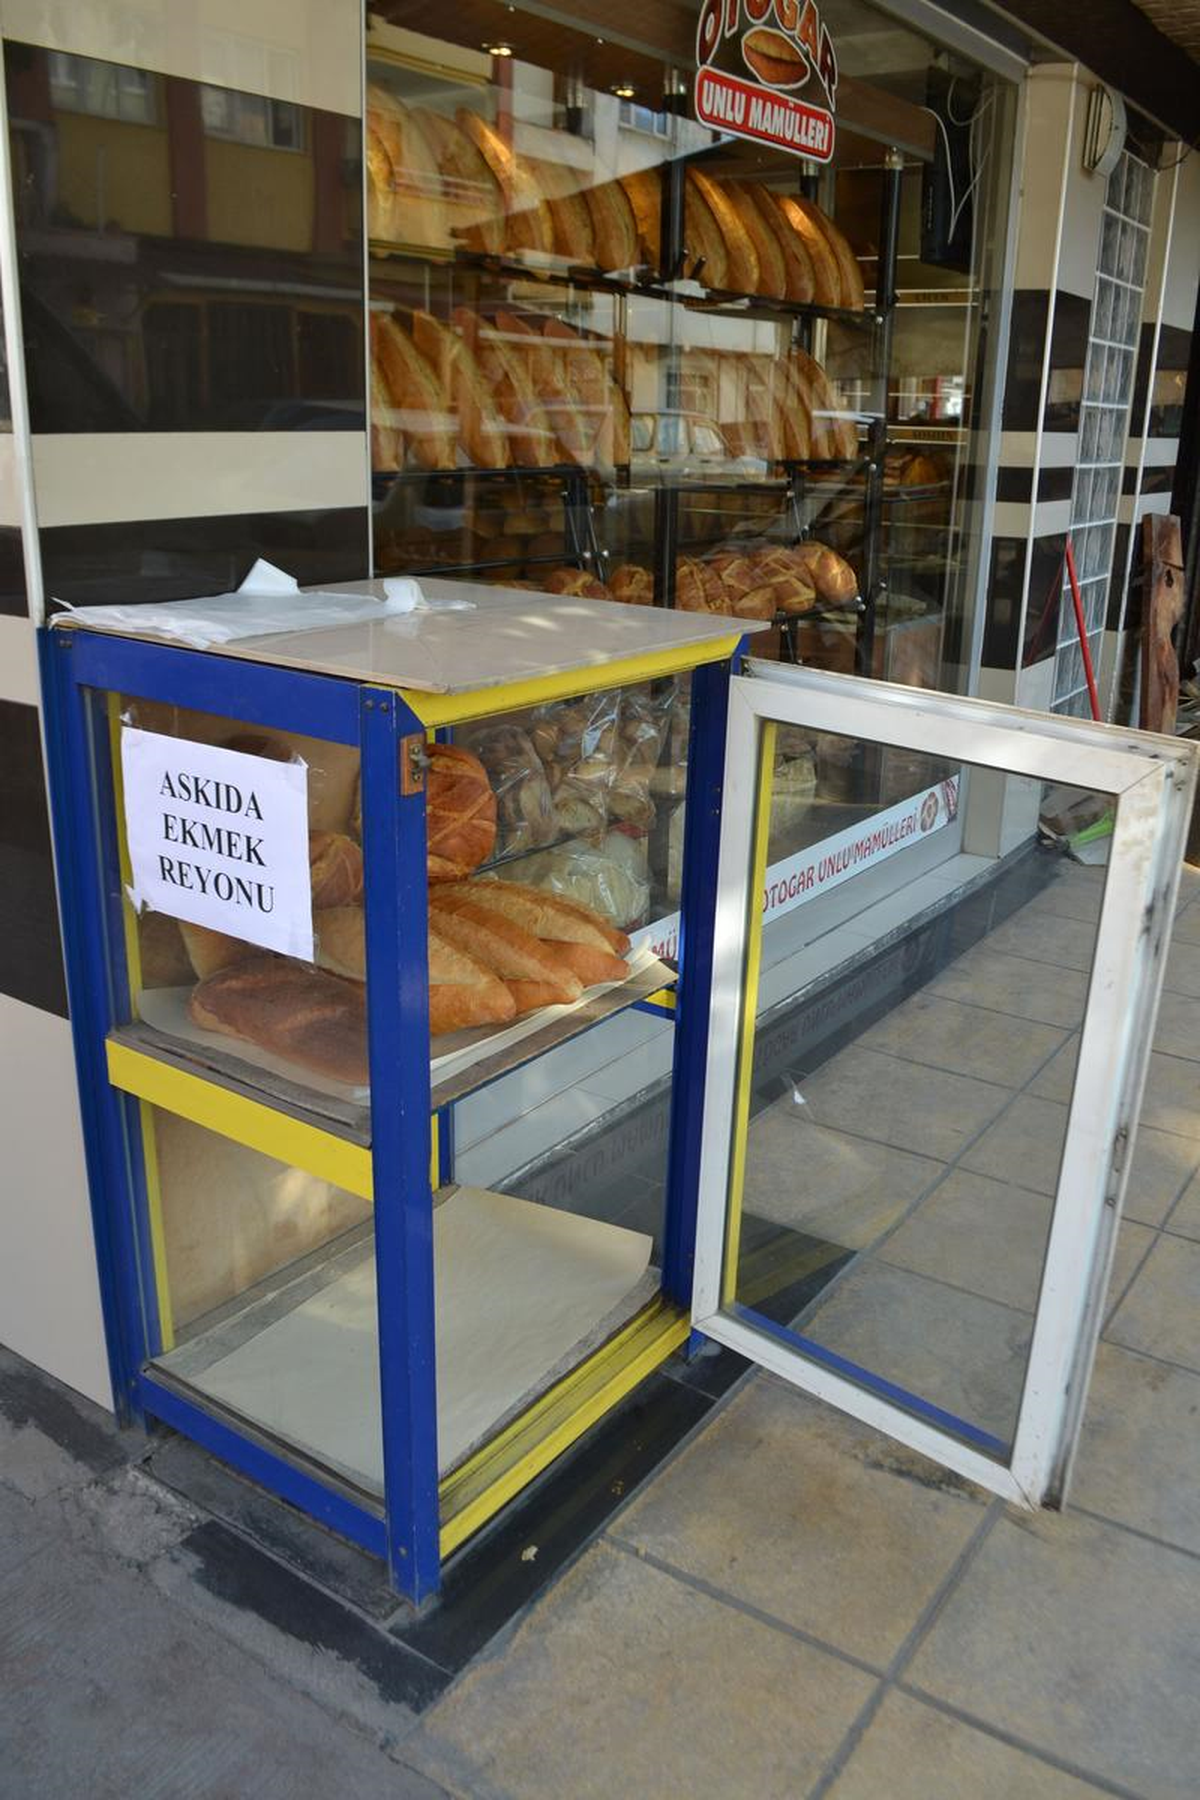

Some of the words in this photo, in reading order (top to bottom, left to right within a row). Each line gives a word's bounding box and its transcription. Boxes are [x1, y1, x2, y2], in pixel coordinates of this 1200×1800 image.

[702, 80, 746, 125] UNLU
[749, 96, 830, 152] MAMÜLLERİ
[159, 770, 264, 821] ASKIDA
[162, 812, 267, 868] EKMEK
[818, 846, 850, 882] UNLU
[852, 807, 918, 864] MAMÜLLERİ
[157, 854, 274, 913] REYONU
